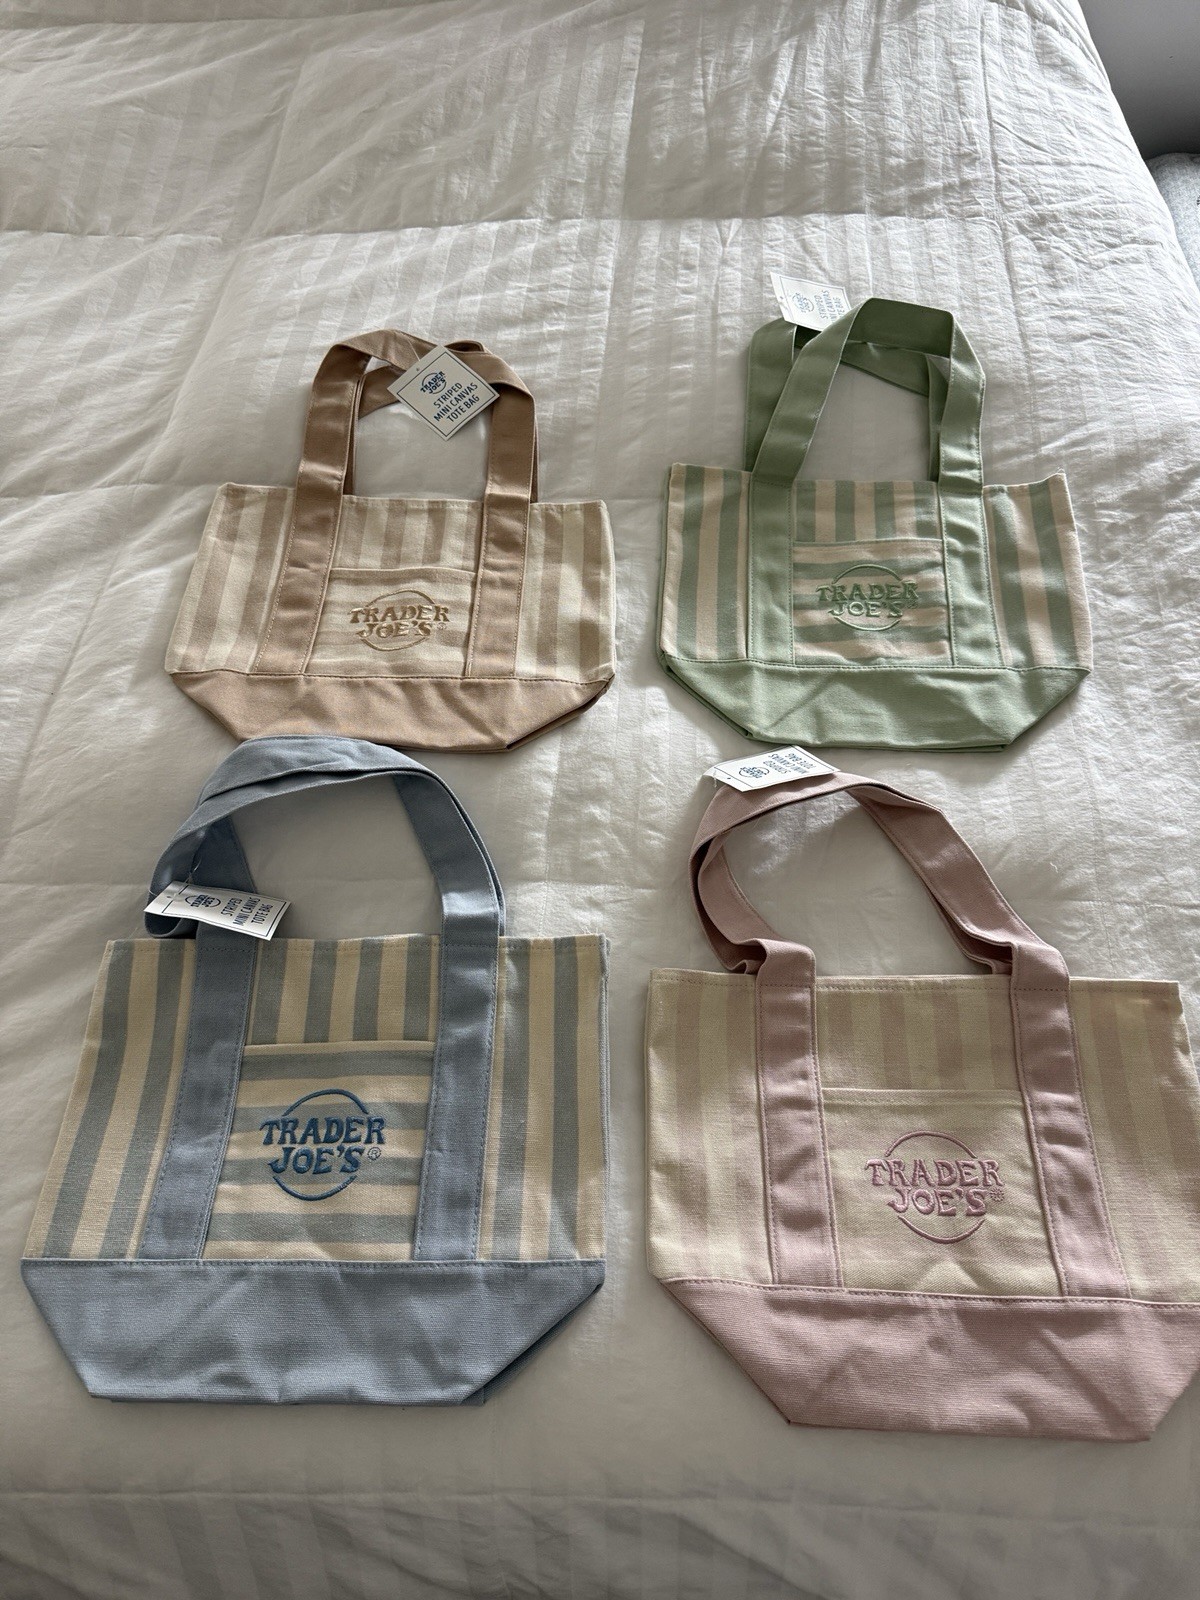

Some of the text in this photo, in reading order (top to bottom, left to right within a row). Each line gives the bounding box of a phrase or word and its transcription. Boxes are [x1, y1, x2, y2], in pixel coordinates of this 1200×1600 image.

[420, 371, 446, 393] TRADER
[429, 377, 446, 394] JOE'S
[433, 382, 463, 409] STRIPED
[433, 382, 478, 422] MINI CANVAS
[446, 394, 480, 422] TOTE BAG
[815, 579, 919, 602] TRADER
[347, 604, 450, 623] TRADER
[828, 600, 903, 618] JOE'S
[356, 620, 433, 638] JOE'S
[220, 897, 243, 916] STRIPED
[232, 896, 261, 926] MINI CANVAS
[250, 903, 273, 925] TOTE BAG
[260, 1115, 386, 1145] TRADER
[267, 1145, 365, 1174] JOE'S
[864, 1158, 1005, 1187] TRADER
[887, 1186, 988, 1216] JOE'S
